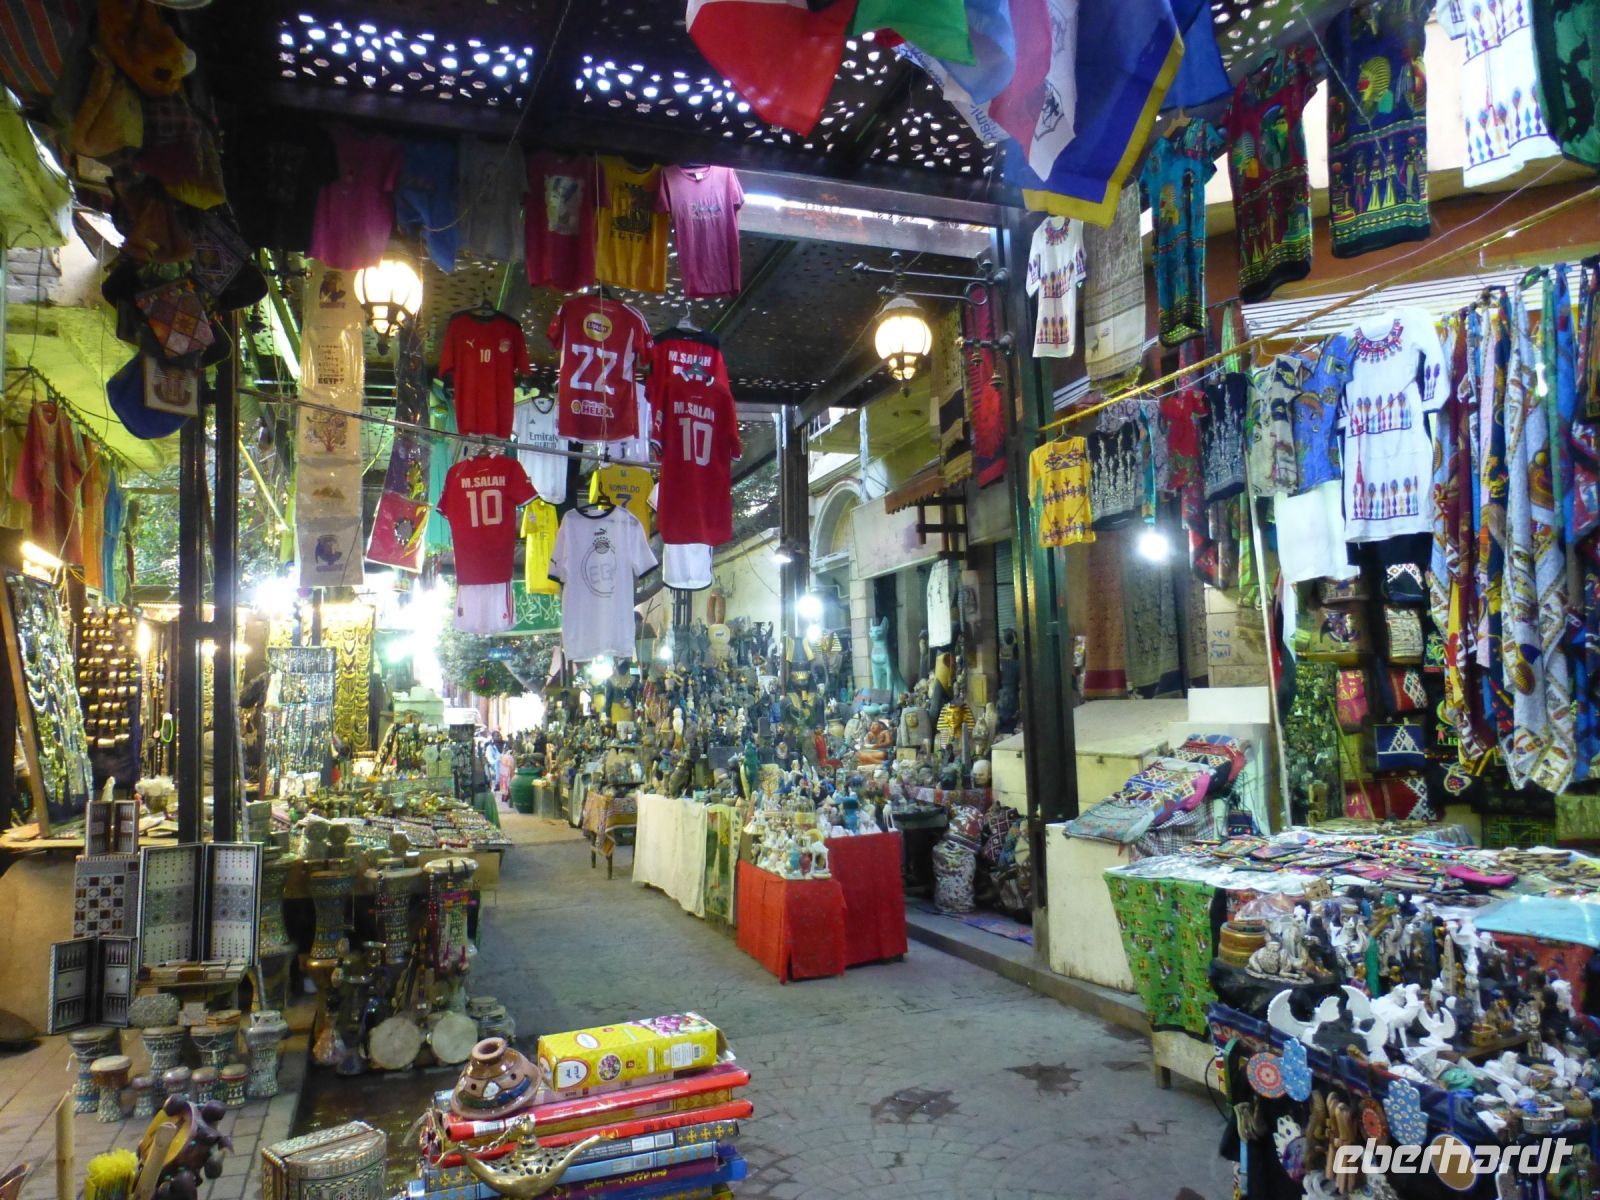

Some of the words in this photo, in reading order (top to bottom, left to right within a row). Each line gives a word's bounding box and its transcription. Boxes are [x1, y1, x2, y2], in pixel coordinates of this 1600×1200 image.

[480, 349, 491, 363] 10
[570, 343, 618, 395] 22
[679, 417, 713, 466] 10
[461, 475, 506, 489] M.SALAH
[466, 489, 503, 528] 10
[615, 493, 632, 508] 7
